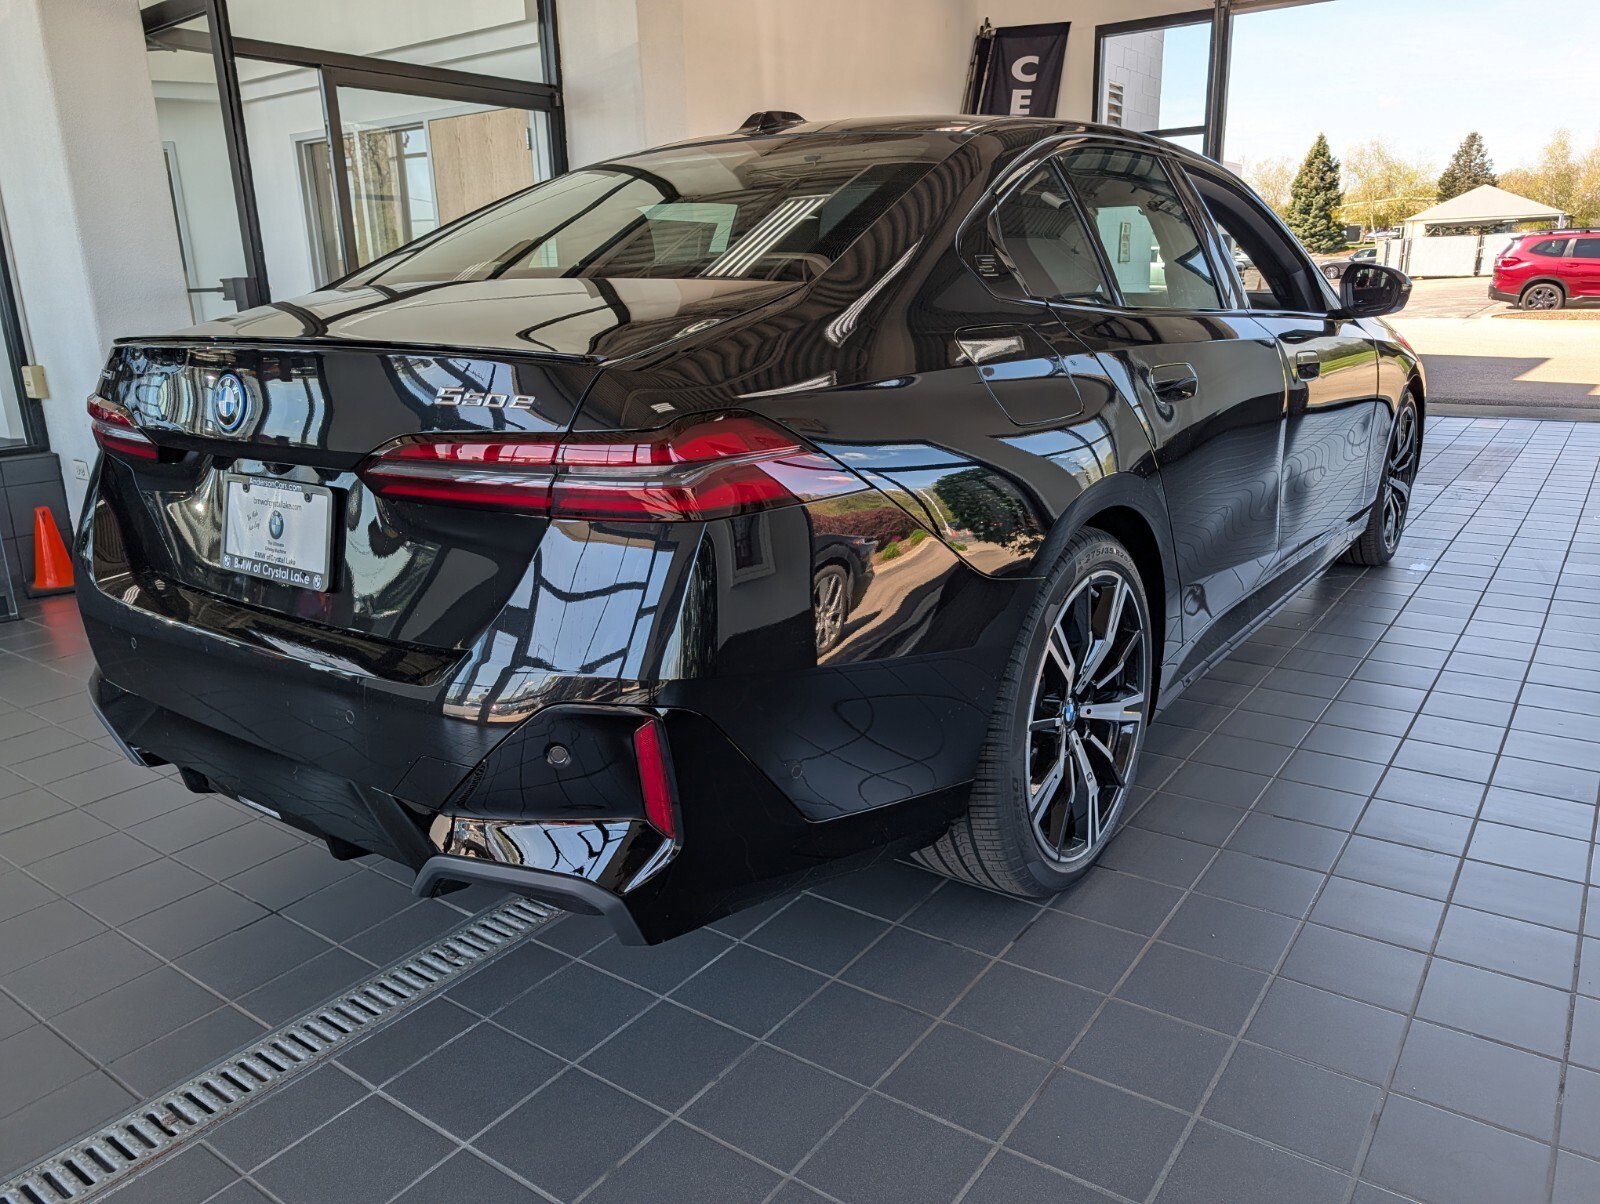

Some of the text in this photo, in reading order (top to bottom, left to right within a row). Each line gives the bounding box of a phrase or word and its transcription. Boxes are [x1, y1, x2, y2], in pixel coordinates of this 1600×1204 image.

[253, 563, 261, 573] of
[262, 564, 289, 580] Crystal
[290, 569, 310, 585] Lake
